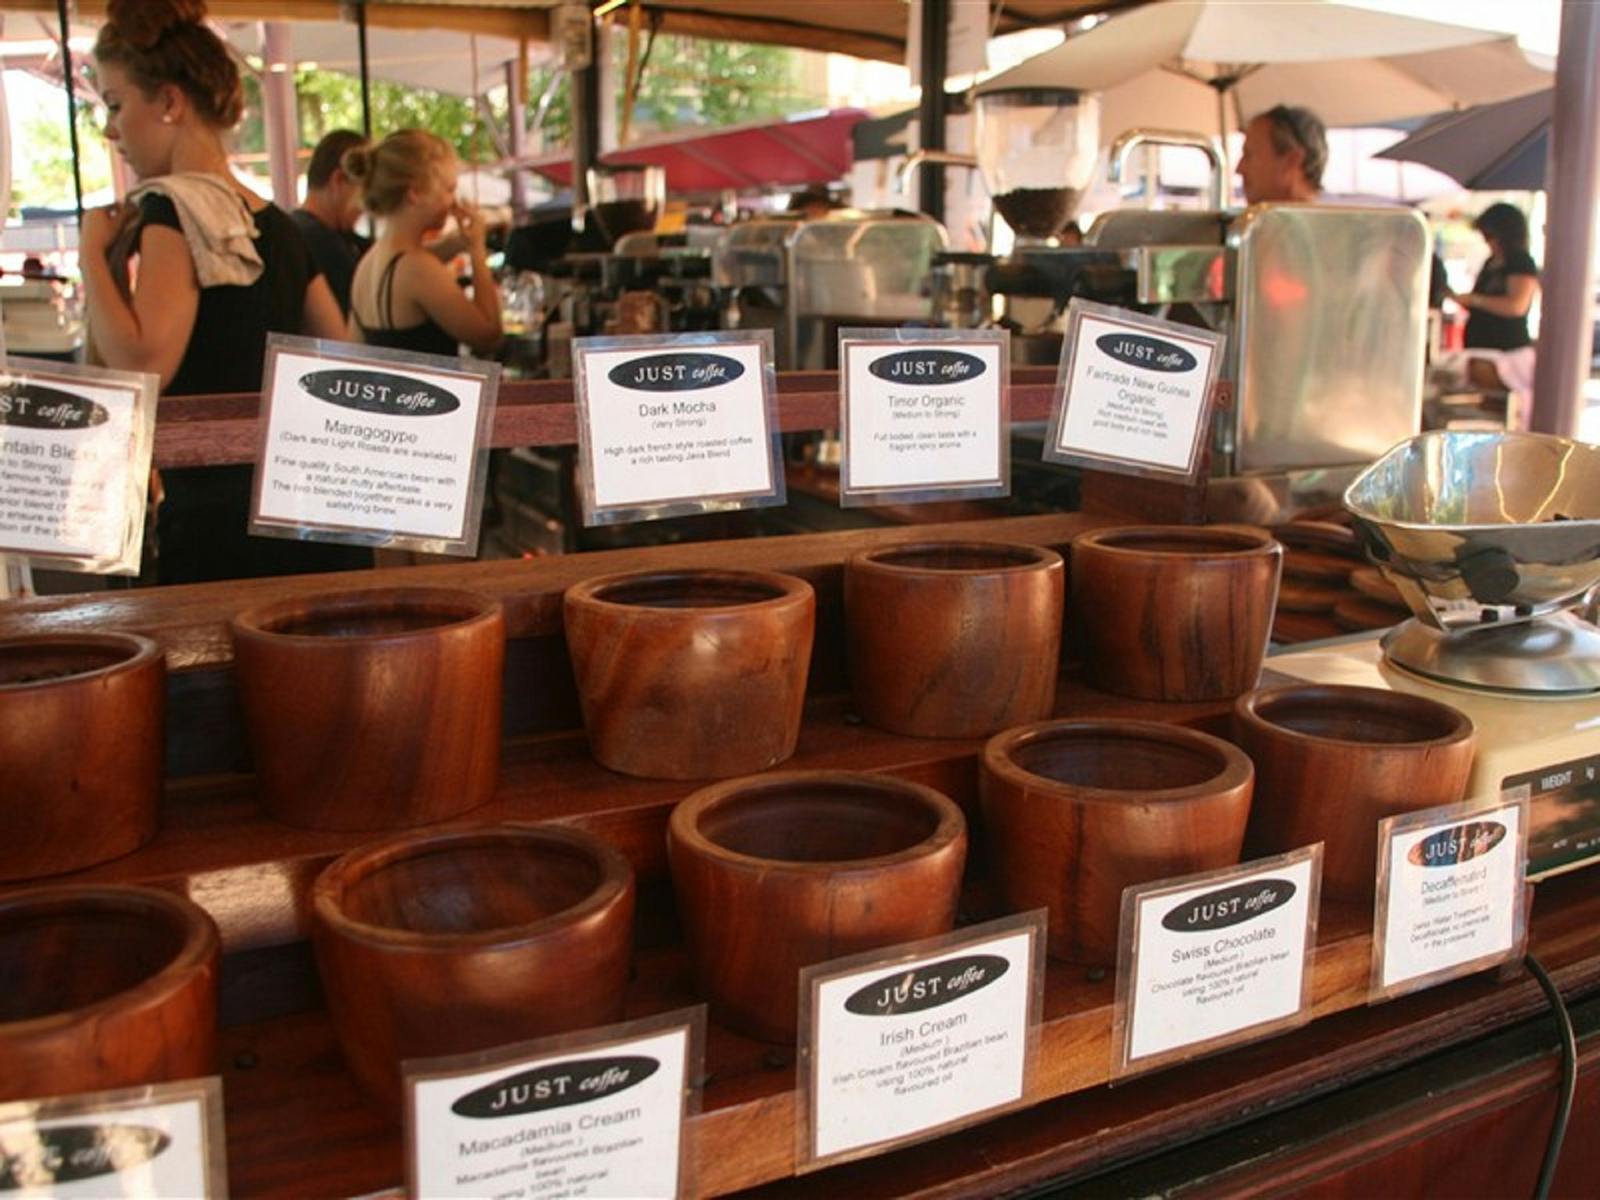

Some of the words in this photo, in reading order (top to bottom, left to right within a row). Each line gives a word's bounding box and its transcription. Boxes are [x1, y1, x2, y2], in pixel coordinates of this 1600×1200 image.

[1114, 341, 1155, 361] JUST
[1156, 352, 1185, 368] coffee
[634, 366, 686, 383] JUST
[692, 363, 726, 382] coffee
[891, 361, 937, 376] JUST
[940, 360, 970, 378] coffee
[1086, 366, 1130, 386] Fairtrade
[1132, 377, 1154, 391] New
[1157, 382, 1190, 398] Guinea
[328, 380, 391, 402] JUST
[395, 390, 436, 410] coffee
[639, 404, 669, 418] Dark
[673, 400, 716, 415] Mocha
[888, 396, 918, 408] Timor
[922, 395, 966, 410] Organic
[1118, 388, 1156, 406] Organic
[0, 397, 30, 415] ST
[37, 403, 83, 426] coffee
[324, 418, 418, 444] Maragogype
[3, 441, 44, 457] ntain
[280, 431, 307, 443] (Dark
[310, 436, 328, 446] and
[332, 438, 354, 450] Light
[358, 440, 390, 452] Roasts
[412, 450, 456, 464] available)
[627, 444, 646, 454] dark
[675, 441, 694, 452] style
[275, 456, 296, 466] Fine
[299, 460, 330, 472] quality
[334, 462, 362, 474] South
[364, 467, 408, 479] American
[438, 476, 456, 485] with
[316, 474, 348, 484] natural
[272, 480, 290, 490] The
[314, 486, 352, 497] blended
[1187, 898, 1241, 924] JUST
[1244, 888, 1278, 911] coffee
[1171, 945, 1210, 964] Swiss
[1214, 926, 1276, 954] Chocolate
[876, 977, 941, 1008] JUST
[946, 964, 986, 990] coffee
[1151, 974, 1194, 994] Chocolate
[1196, 964, 1234, 982] flavoured
[1236, 956, 1268, 972] Brazilian
[1182, 986, 1206, 998] using
[1232, 968, 1260, 984] natural
[1196, 987, 1234, 1005] flavoured
[880, 1026, 914, 1046] Irish
[919, 1012, 968, 1037] Cream
[832, 1070, 856, 1086] Irish
[858, 1062, 894, 1079] Cream
[895, 1050, 941, 1069] flavoured
[943, 1038, 983, 1056] Brazilian
[985, 1030, 1009, 1044] bean
[875, 1075, 905, 1090] using
[908, 1065, 935, 1080] 100%
[936, 1054, 969, 1072] natural
[490, 1075, 574, 1111] JUST
[578, 1066, 631, 1094] coffee
[894, 1077, 940, 1096] flavoured
[458, 1120, 573, 1158] Macadamia
[578, 1106, 642, 1132] Cream
[456, 1161, 529, 1186] Macadamia
[532, 1149, 590, 1168] flavoured
[592, 1136, 645, 1156] Brazilian
[520, 1138, 576, 1160] (Medium
[530, 1178, 563, 1192] 100%
[566, 1168, 610, 1186] natural
[535, 1166, 568, 1181] bean
